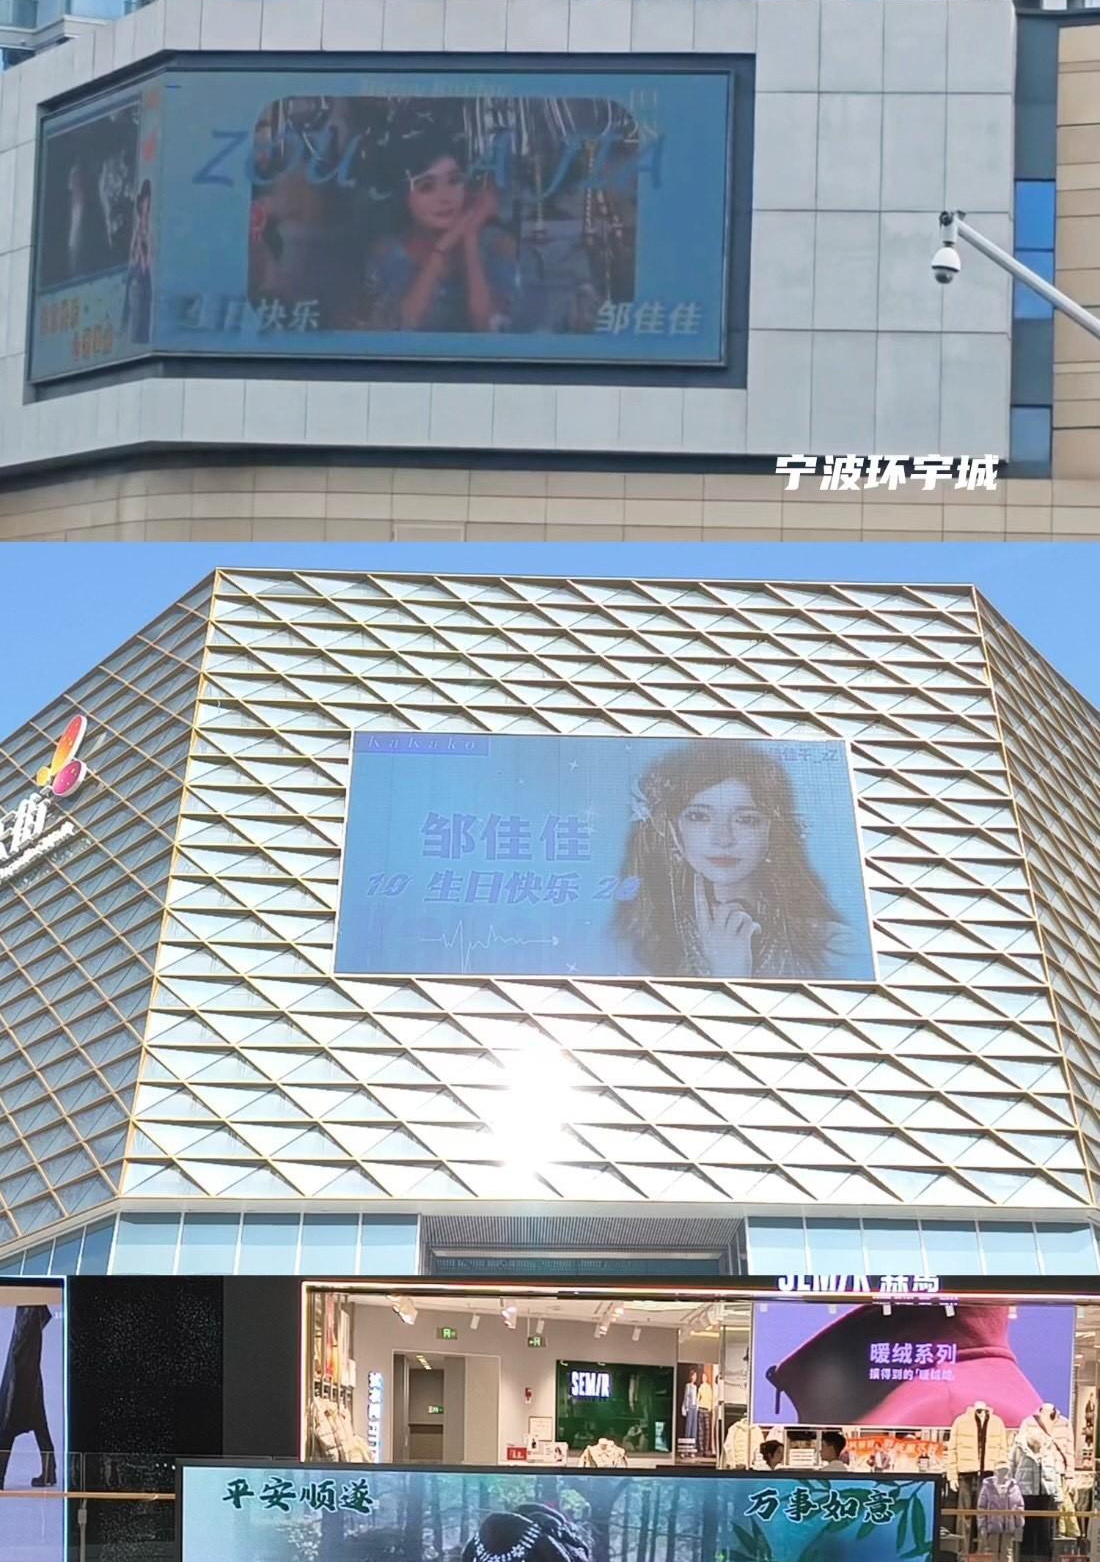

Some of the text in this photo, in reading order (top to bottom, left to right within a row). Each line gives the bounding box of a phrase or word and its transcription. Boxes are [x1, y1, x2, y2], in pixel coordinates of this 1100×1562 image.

[192, 125, 359, 187] ZOU
[595, 300, 703, 336] 邹佳佳
[420, 811, 592, 862] 邹佳佳
[423, 870, 580, 904] 生日快乐
[869, 1342, 957, 1365] 暖绒系列
[222, 1476, 376, 1515] 平安顺遂
[744, 1485, 897, 1524] 万事如意
